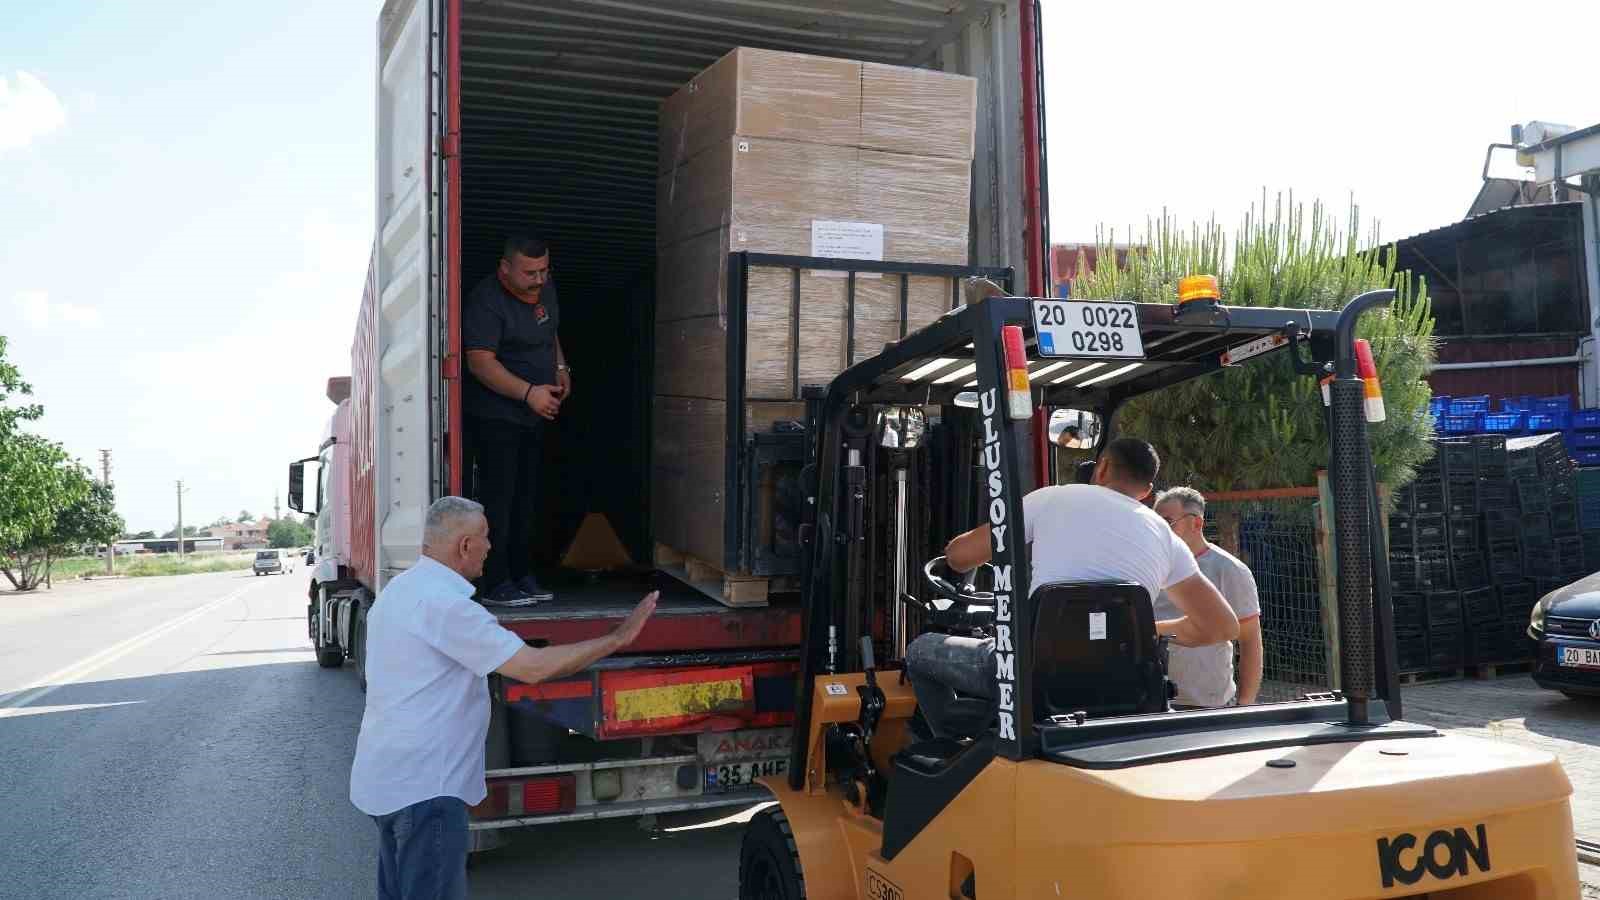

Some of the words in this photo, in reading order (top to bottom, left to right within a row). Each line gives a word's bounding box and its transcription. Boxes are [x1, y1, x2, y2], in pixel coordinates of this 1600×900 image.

[1039, 304, 1066, 326] 20
[1082, 306, 1135, 329] 0022
[1071, 331, 1124, 352] 0298
[980, 387, 1007, 553] ULUSOY
[993, 564, 1016, 741] MERMER
[1566, 649, 1579, 663] 20
[719, 765, 740, 785] 35
[1376, 824, 1491, 888] ICON
